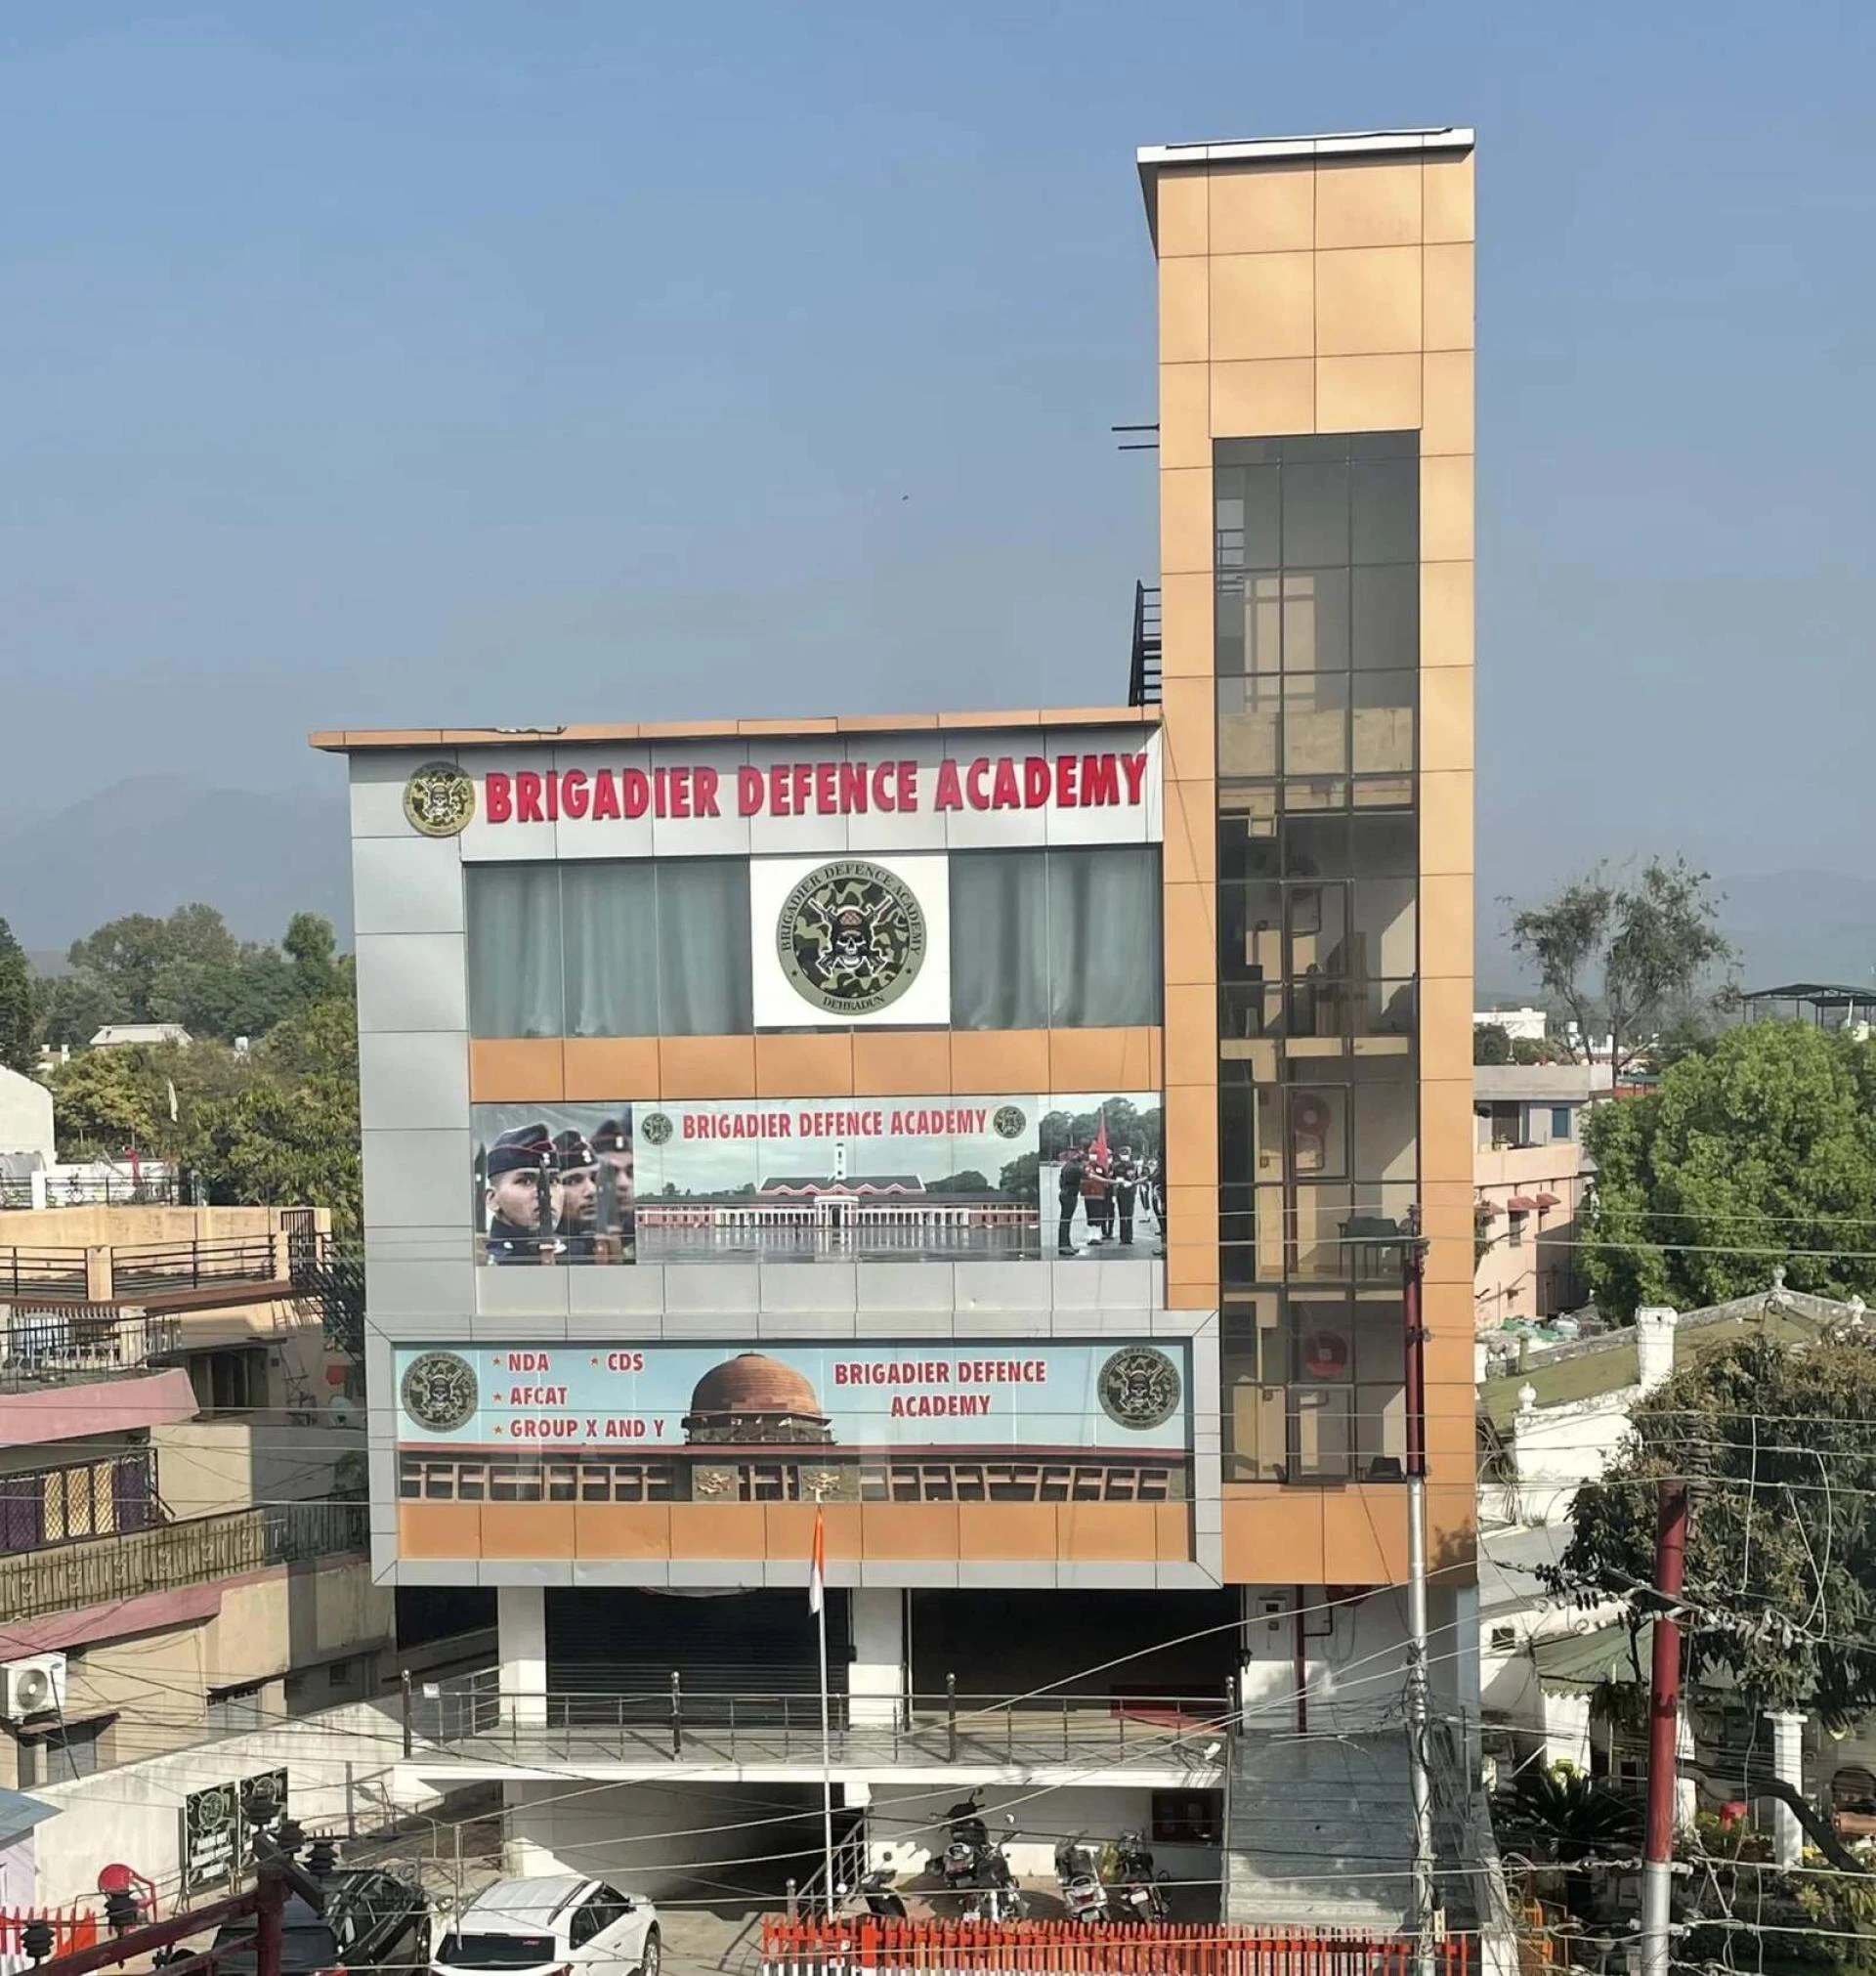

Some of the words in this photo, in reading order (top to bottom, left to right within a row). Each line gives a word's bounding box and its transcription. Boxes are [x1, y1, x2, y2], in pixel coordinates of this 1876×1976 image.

[485, 766, 720, 823] BRIGADIER
[737, 761, 918, 815] DEFENCE
[935, 752, 1148, 810] ACADEMY
[781, 875, 822, 952] BRIGADIER
[824, 864, 892, 887] DEFENCE
[891, 884, 922, 956] ACADEMY
[822, 994, 885, 1011] DEHRADUN
[683, 1113, 791, 1138] BRIGADIER
[799, 1111, 882, 1138] DEFENCE
[890, 1109, 987, 1135] ACADEMY
[508, 1353, 550, 1371] NDA
[608, 1353, 644, 1371] CDS
[834, 1362, 950, 1385] BRIGADIER
[958, 1361, 1046, 1383] DEFENCE
[510, 1387, 568, 1405] AFCAT
[891, 1395, 991, 1417] ACADEMY
[510, 1419, 578, 1438] GROUP
[586, 1419, 598, 1438] X
[605, 1419, 647, 1438] AND
[654, 1419, 664, 1438] Y
